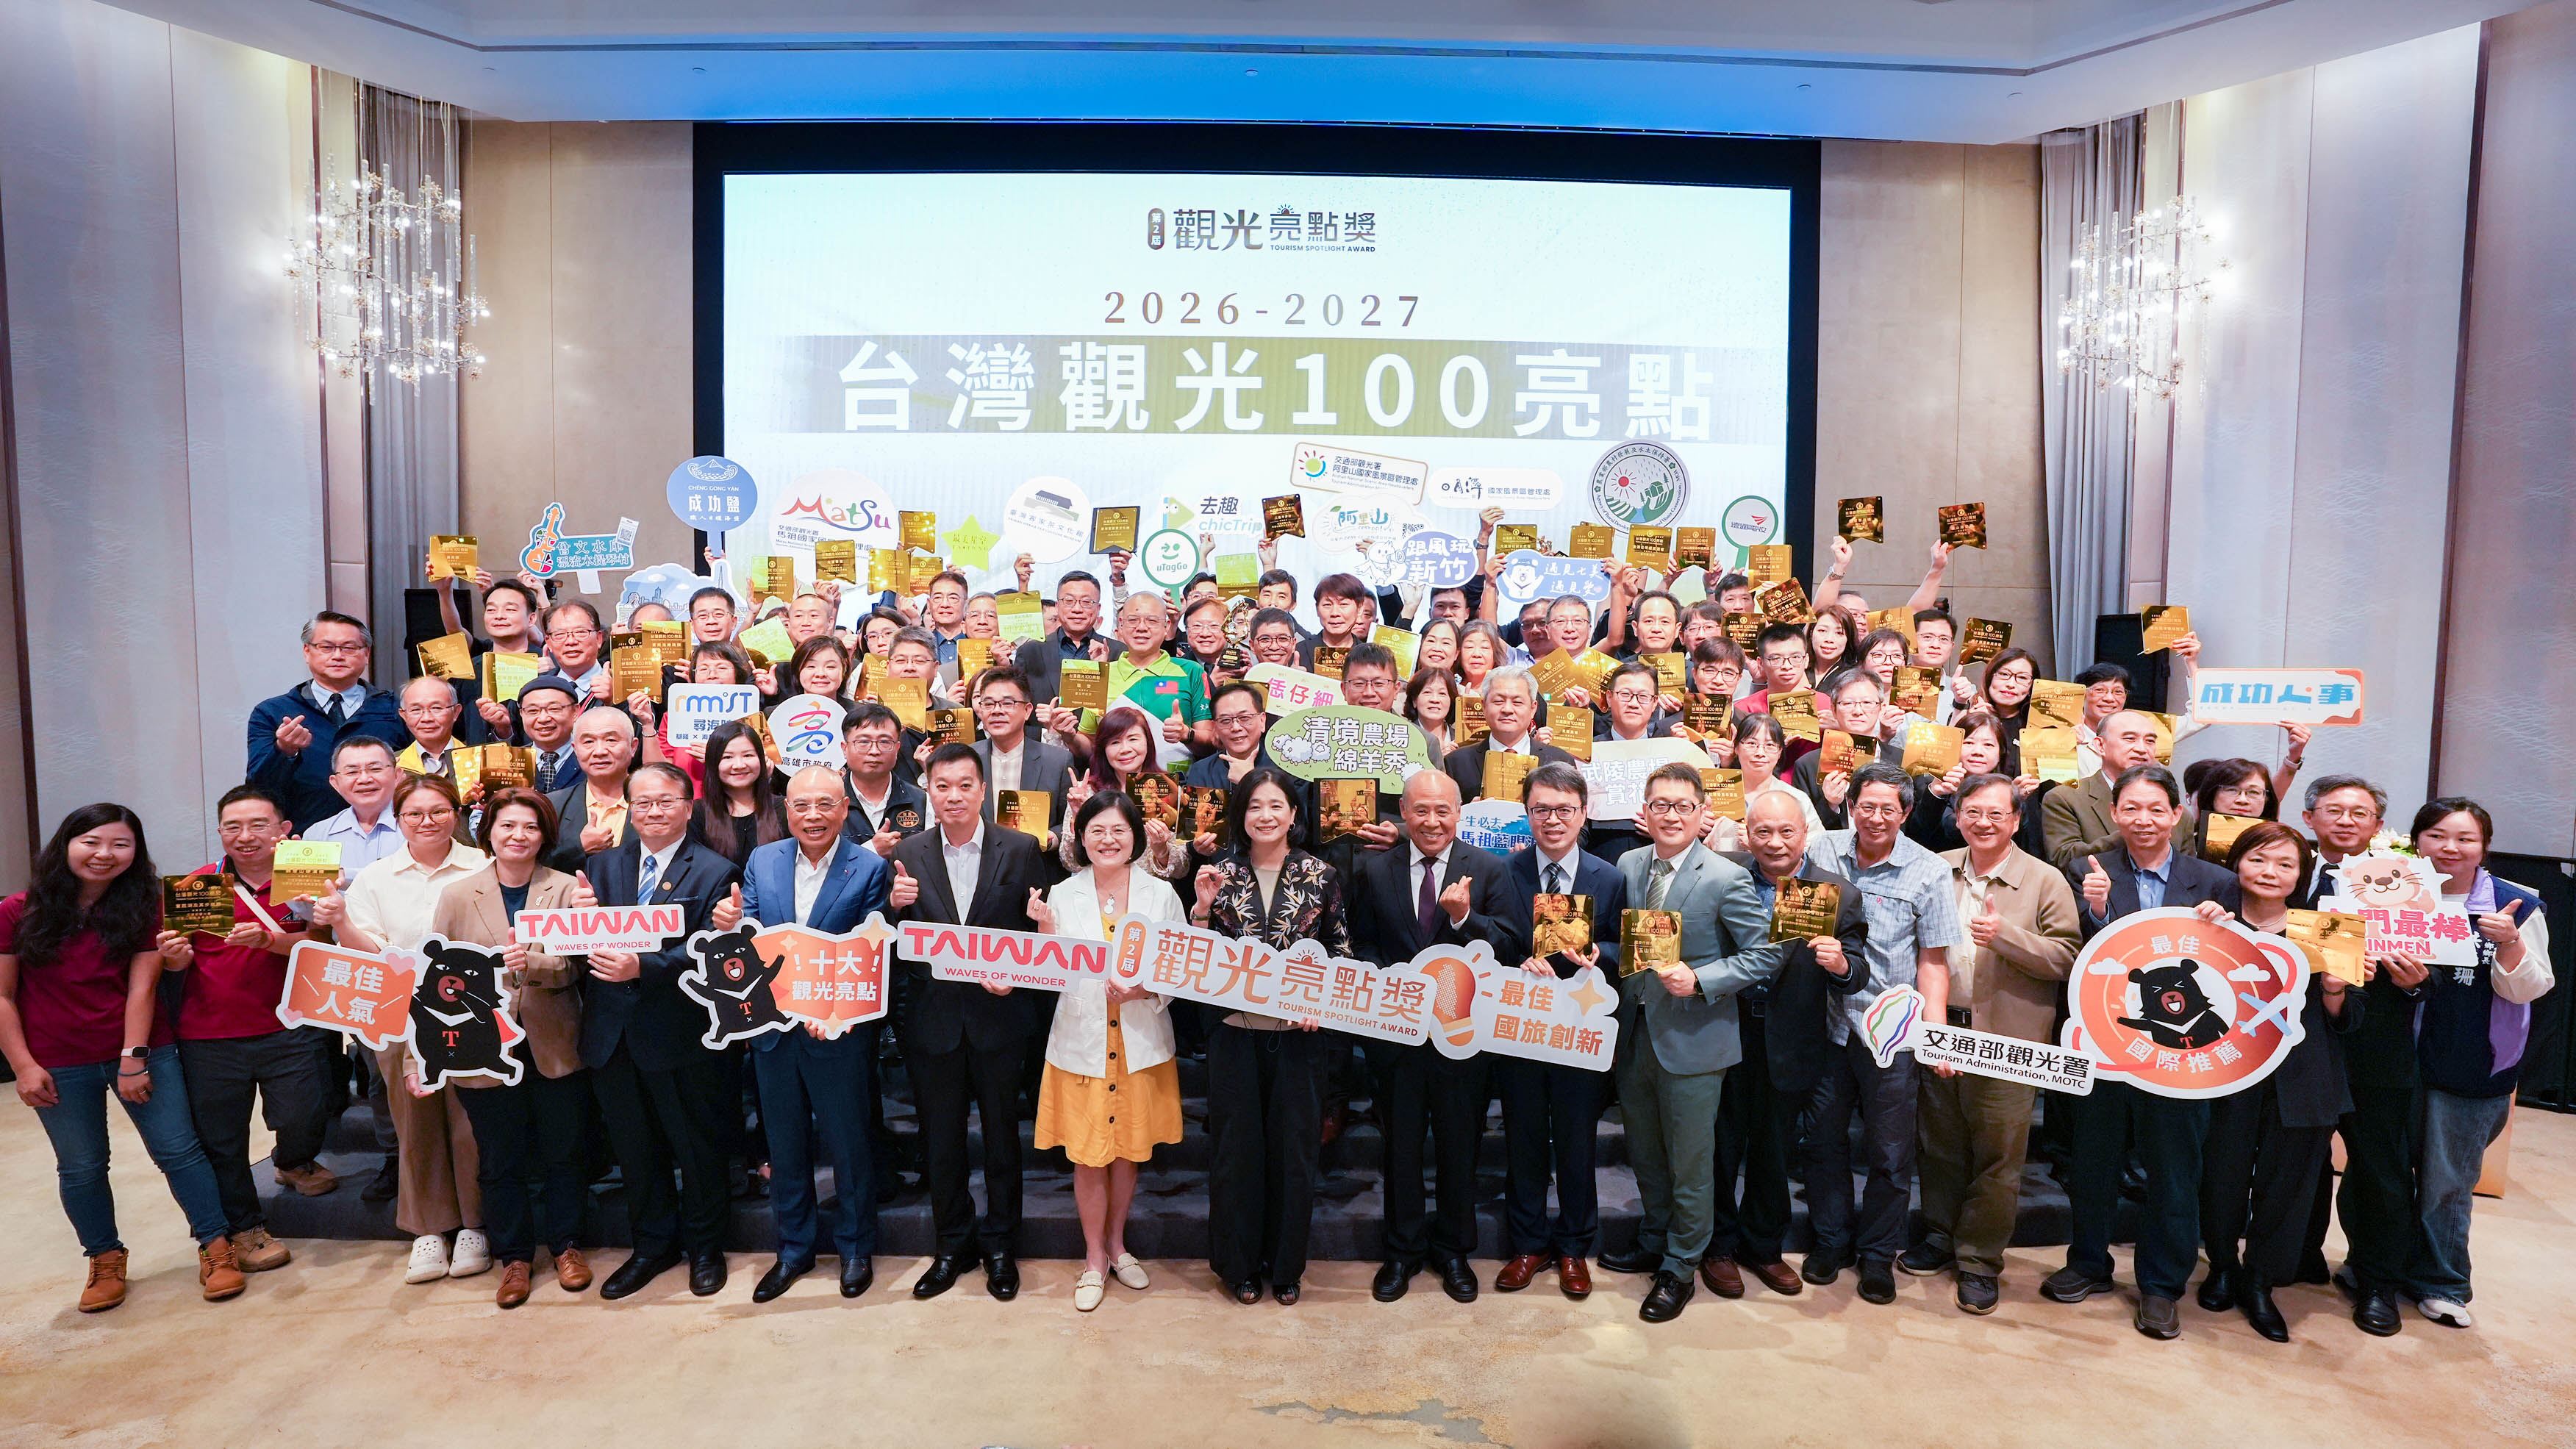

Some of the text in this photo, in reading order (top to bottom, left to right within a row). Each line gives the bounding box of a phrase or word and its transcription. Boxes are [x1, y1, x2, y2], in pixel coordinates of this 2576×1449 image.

[1151, 212, 1162, 246] 第2屆
[1173, 209, 1375, 251] 觀光亮點獎
[1104, 292, 1418, 327] 2026-2027
[839, 340, 1714, 441] 台灣觀光100亮點
[1332, 464, 1419, 486] 阿里山國家風景區管理處
[1334, 456, 1381, 471] 交通部觀光署
[689, 493, 740, 513] 成功鹽
[1201, 496, 1239, 515] 去趣
[1199, 518, 1263, 534] chicTrip
[1406, 537, 1473, 557] 跟風玩
[1156, 562, 1188, 573] uTagGo
[1409, 557, 1468, 584] 新竹
[1544, 561, 1604, 580] 遇見七美
[2200, 682, 2355, 705] 成功人事
[1302, 715, 1410, 748] 清境農場
[1334, 748, 1408, 775] 綿羊秀
[1460, 815, 1503, 830] 生必去
[520, 909, 680, 937] TAIWAN
[2329, 908, 2471, 944] 門最棒
[554, 940, 651, 951] WAVES OF WONDER
[904, 926, 1106, 974] TAIWAN
[1126, 926, 1142, 973] 第2屆
[2150, 933, 2201, 956] 最佳
[2367, 938, 2431, 956] INMEN
[321, 957, 384, 995] 最佳
[944, 966, 1067, 987] WAVES OF WONDER
[1151, 927, 1427, 1026] 觀光亮點獎
[791, 981, 877, 1002] 觀光亮點
[1497, 979, 1554, 1013] 最佳
[315, 995, 376, 1026] 人氣
[1277, 1000, 1419, 1037] TOURISM SPOTLIGHT AWARD
[1492, 1014, 1605, 1056] 國旅創新
[1922, 1028, 2091, 1080] 交通部觀光署
[2125, 1035, 2244, 1075] 國際推薦
[1922, 1048, 2086, 1090] Tourism Administration, MOTC
